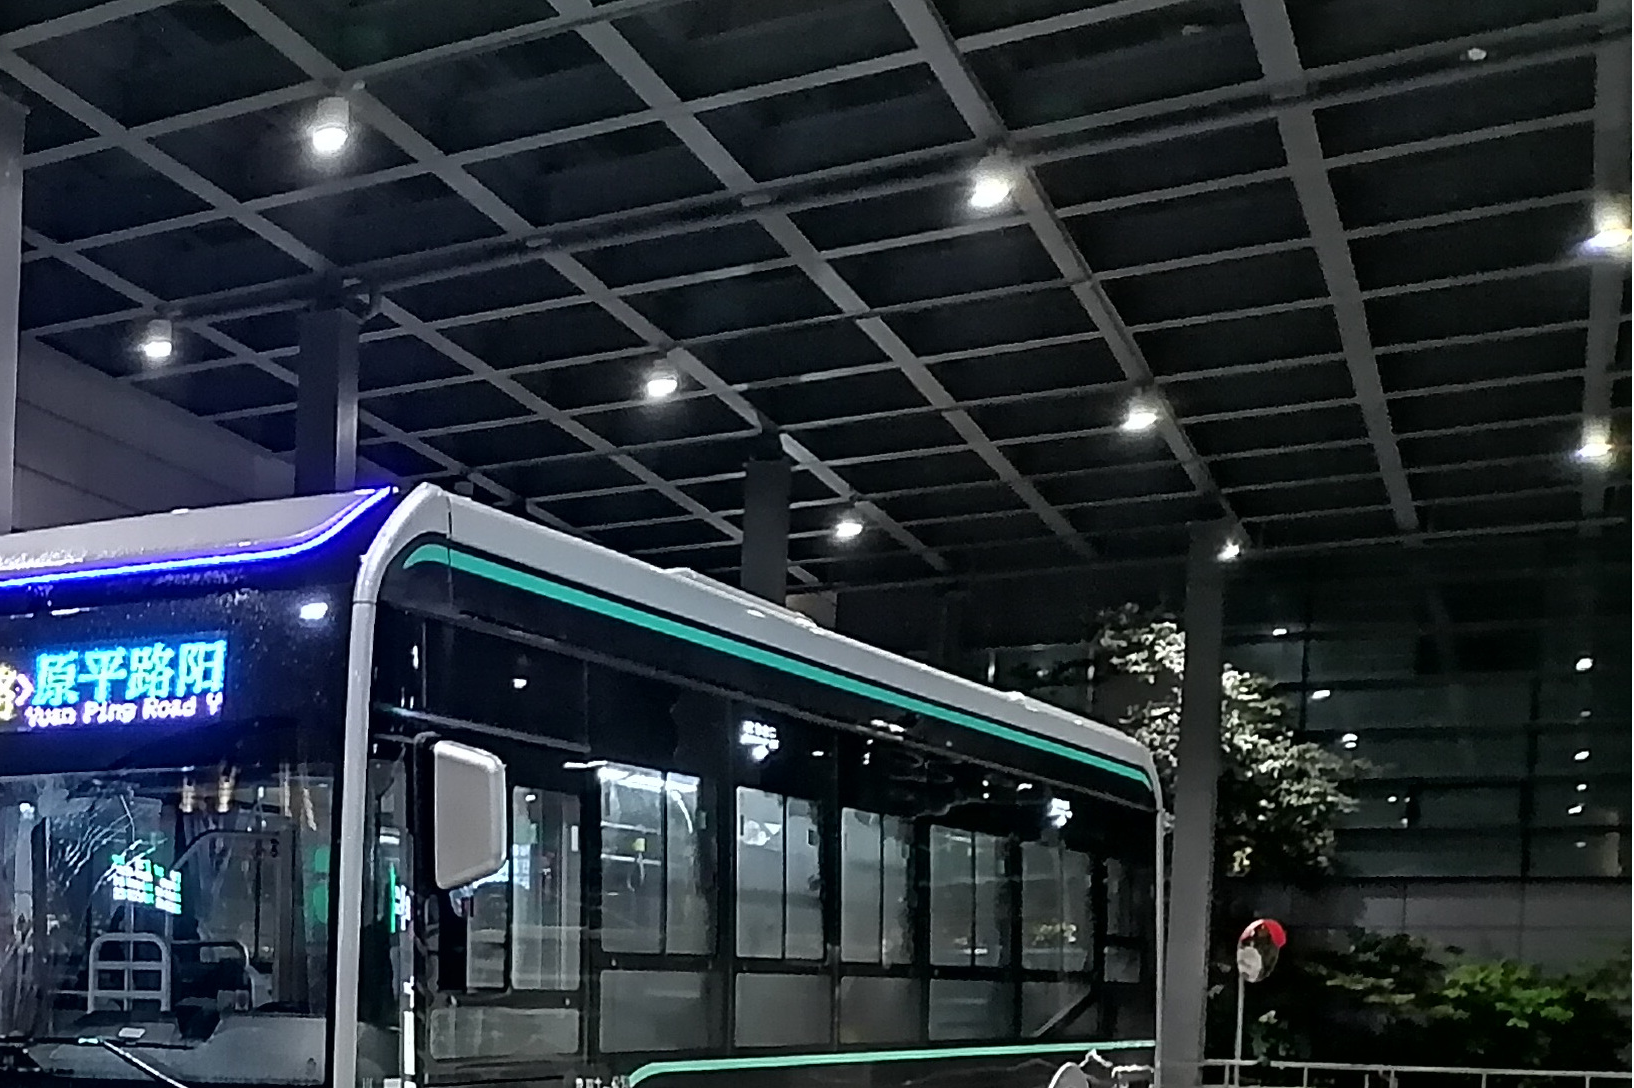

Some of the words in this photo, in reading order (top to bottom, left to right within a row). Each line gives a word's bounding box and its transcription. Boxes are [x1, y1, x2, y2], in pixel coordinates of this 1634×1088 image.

[31, 638, 228, 707] 原平路阳
[83, 701, 137, 725] Ping
[143, 696, 197, 721] Road
[206, 692, 223, 716] Y
